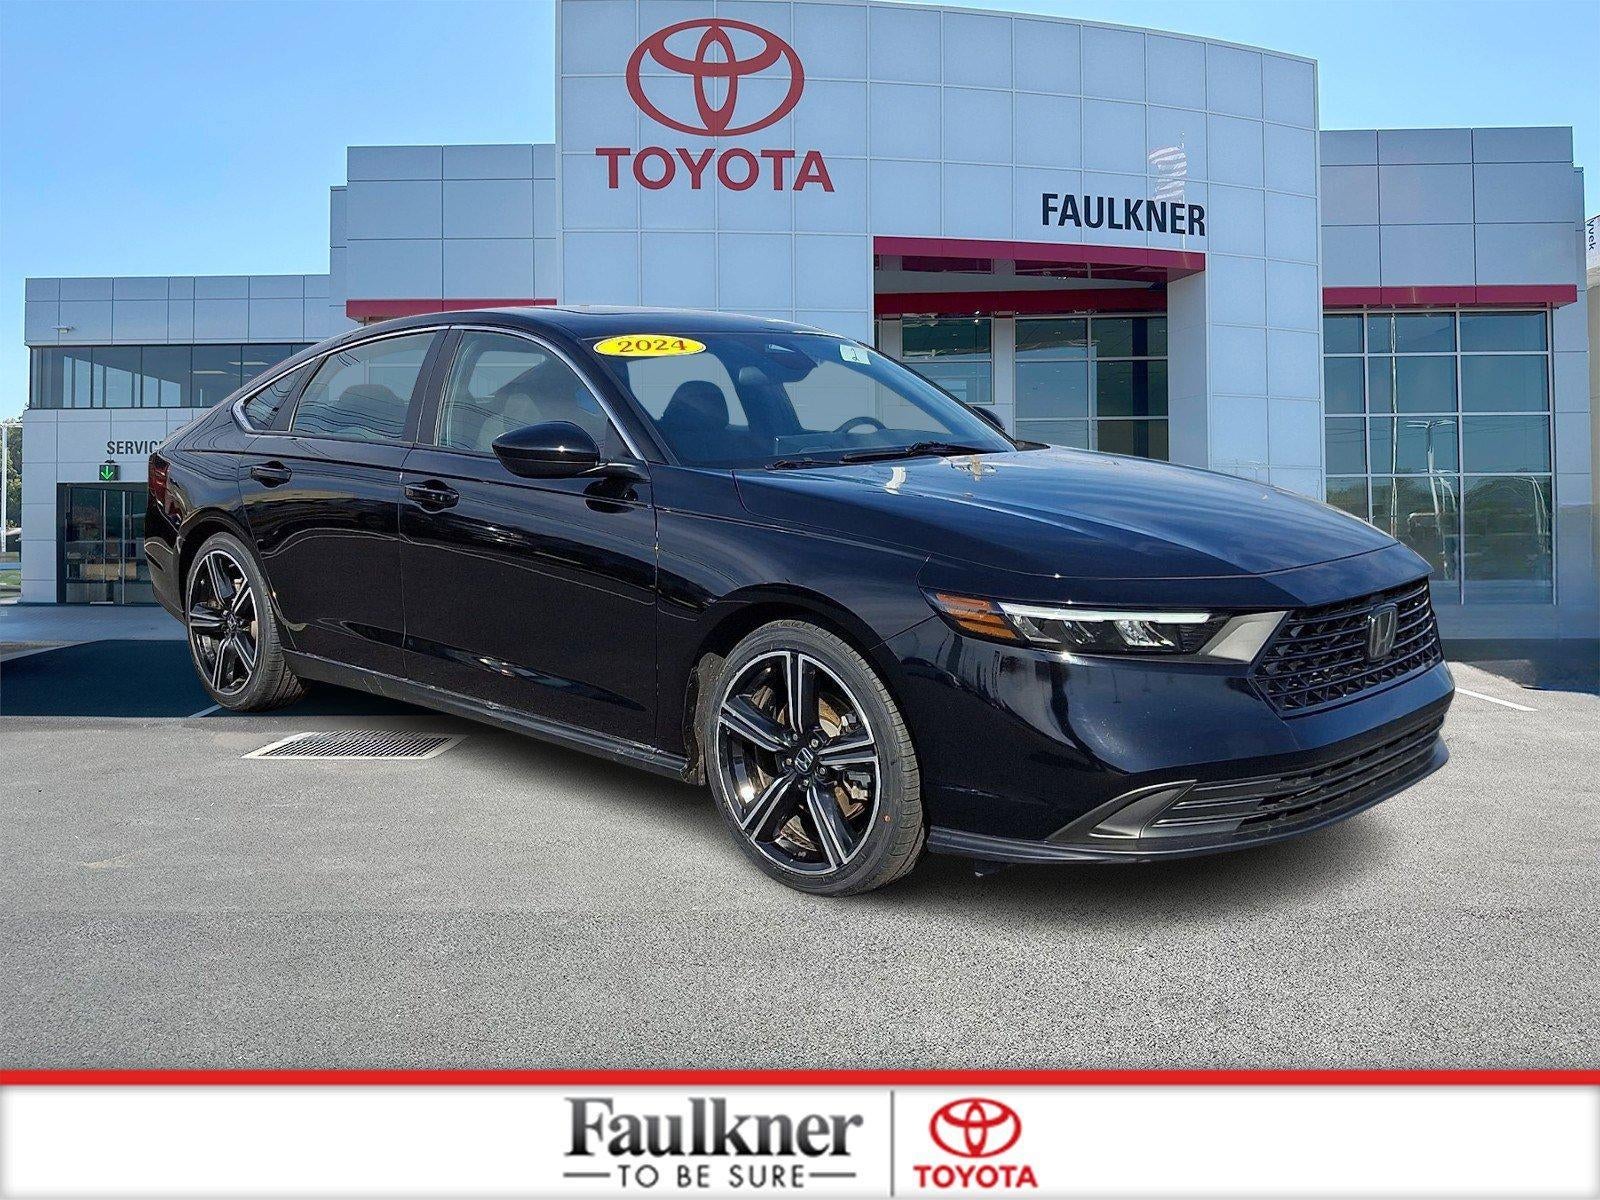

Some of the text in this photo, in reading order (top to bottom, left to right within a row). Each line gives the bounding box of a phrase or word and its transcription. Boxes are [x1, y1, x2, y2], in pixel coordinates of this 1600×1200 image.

[596, 146, 835, 192] TOYOTA
[1042, 193, 1206, 236] FAULKNER
[617, 339, 688, 353] 2024
[106, 440, 163, 455] SERVIC
